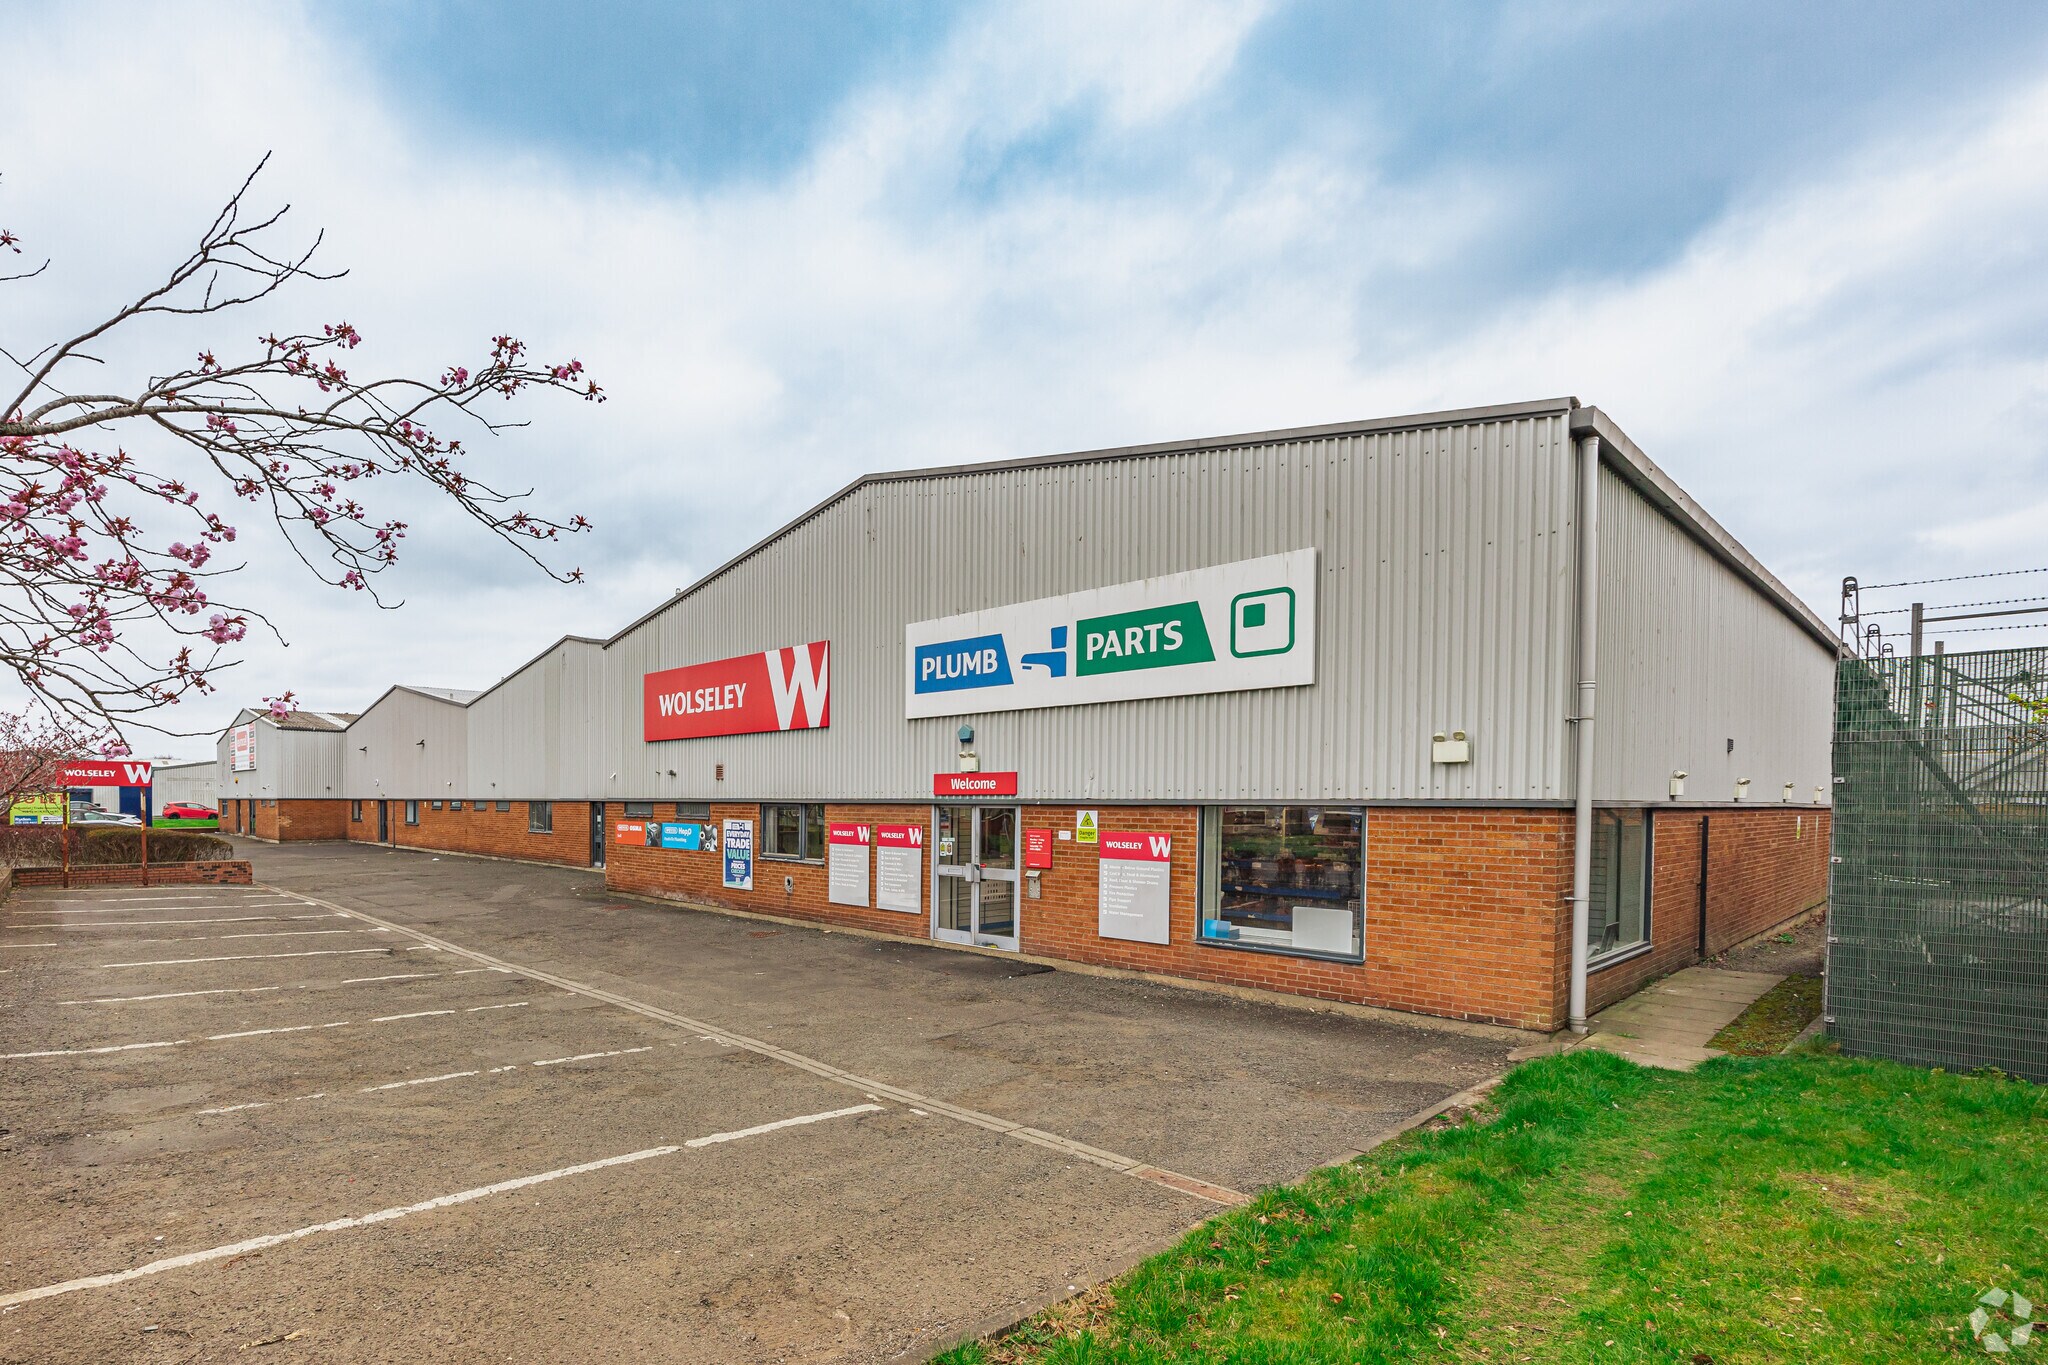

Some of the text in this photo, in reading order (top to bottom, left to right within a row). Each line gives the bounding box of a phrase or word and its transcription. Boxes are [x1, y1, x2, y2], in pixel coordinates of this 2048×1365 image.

[922, 620, 1184, 681] PLUMB PARTS
[659, 640, 828, 731] WOLSELEY W
[64, 764, 152, 784] WOLSELEY W
[950, 777, 996, 790] Welcome
[726, 830, 750, 838] EVERYDAY
[857, 826, 870, 843] W
[908, 826, 923, 845] W
[726, 838, 750, 849] TRADE
[1106, 836, 1171, 858] WOLSELEY W
[726, 849, 750, 860] VALUE
